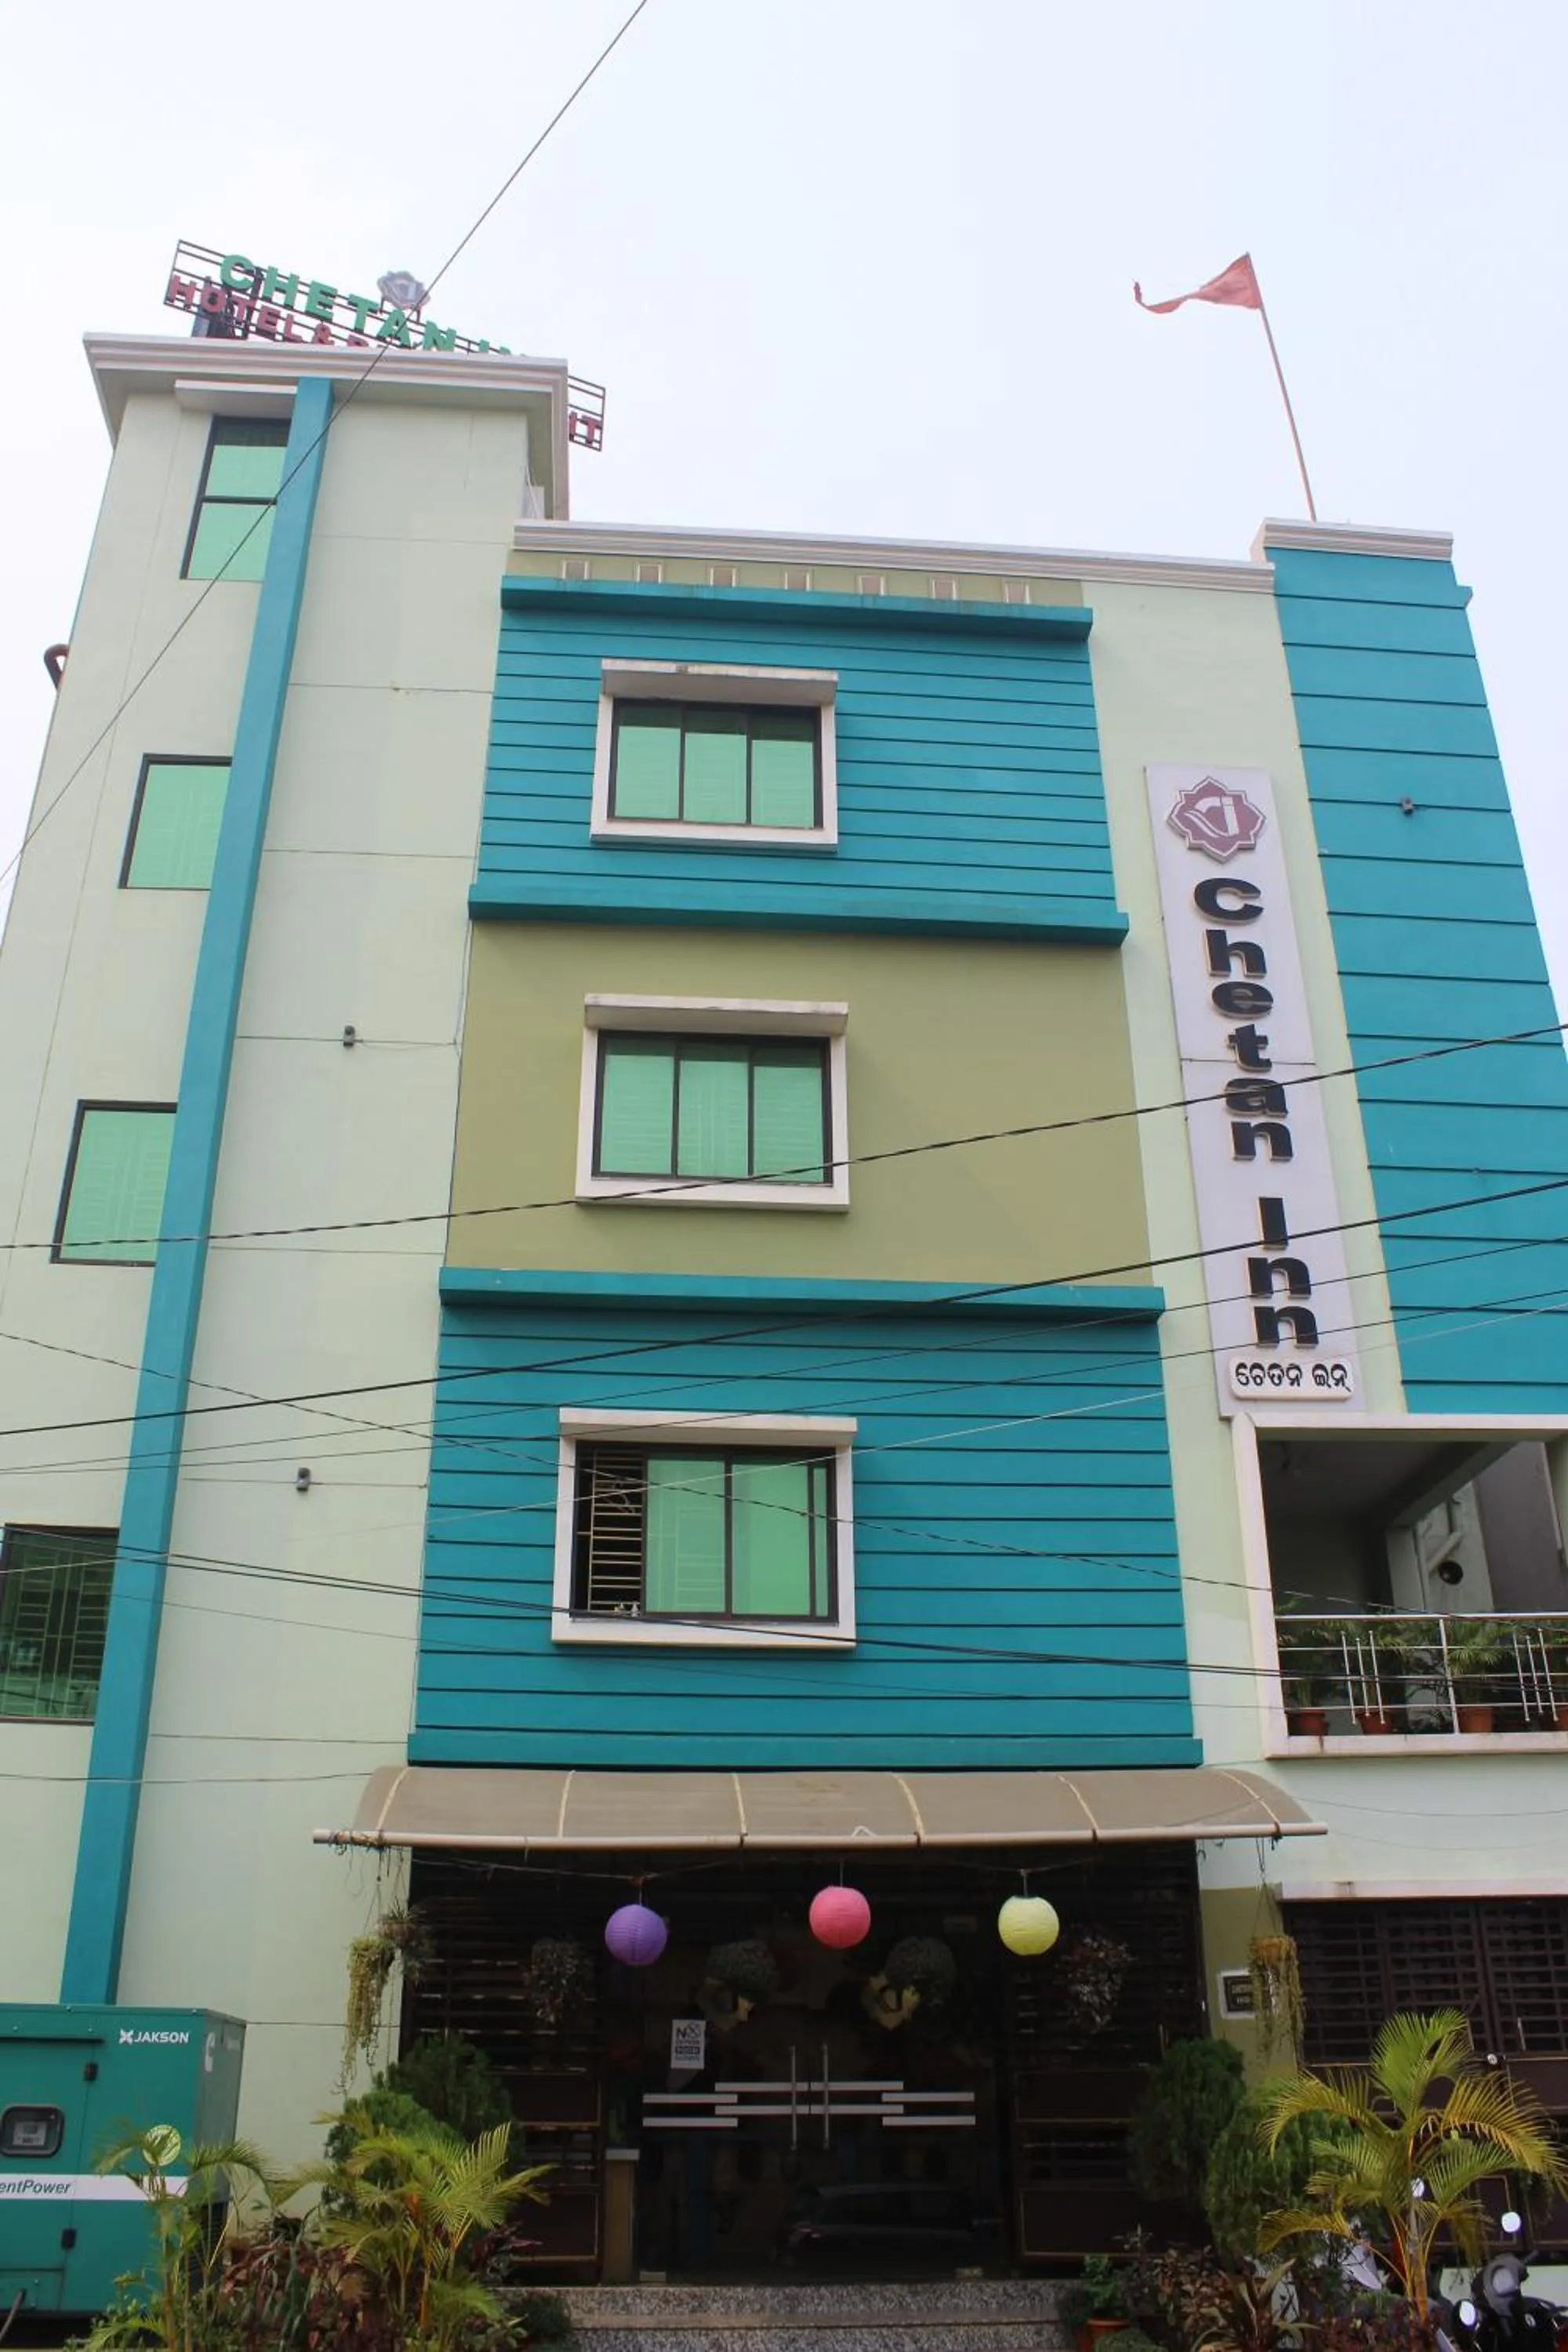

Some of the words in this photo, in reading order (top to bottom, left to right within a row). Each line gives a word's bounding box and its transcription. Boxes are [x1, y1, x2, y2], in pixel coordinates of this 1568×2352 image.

[167, 274, 303, 343] HOTEL
[312, 321, 335, 346] &
[220, 254, 457, 351] CHETAN
[1193, 877, 1294, 1162] Chetan
[1247, 1196, 1319, 1348] Inn
[134, 2031, 189, 2044] JAKSON
